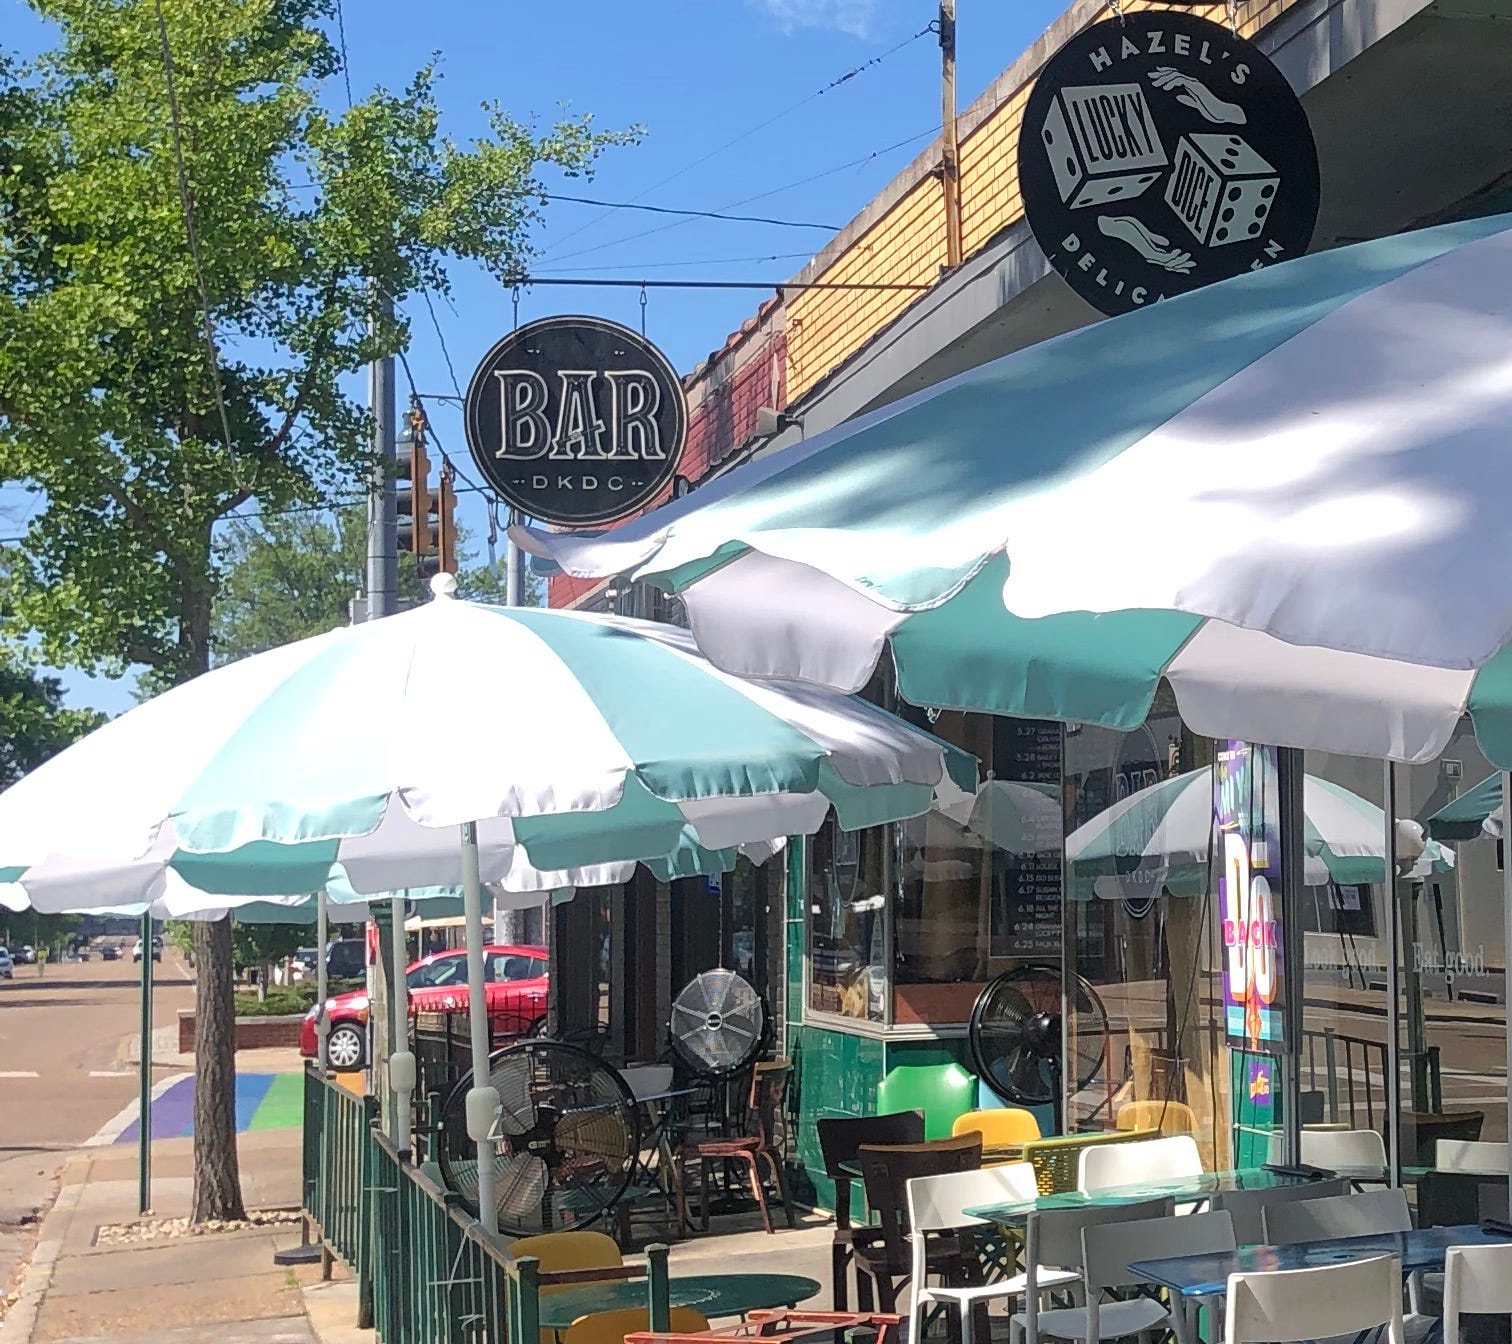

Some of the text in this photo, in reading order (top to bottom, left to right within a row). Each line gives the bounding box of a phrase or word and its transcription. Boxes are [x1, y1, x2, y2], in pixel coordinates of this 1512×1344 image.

[1088, 31, 1250, 85] HAZEL'S
[1072, 92, 1155, 163] LUCKY
[1171, 149, 1215, 232] DICE
[494, 370, 666, 460] BAR
[532, 475, 624, 491] DKDC
